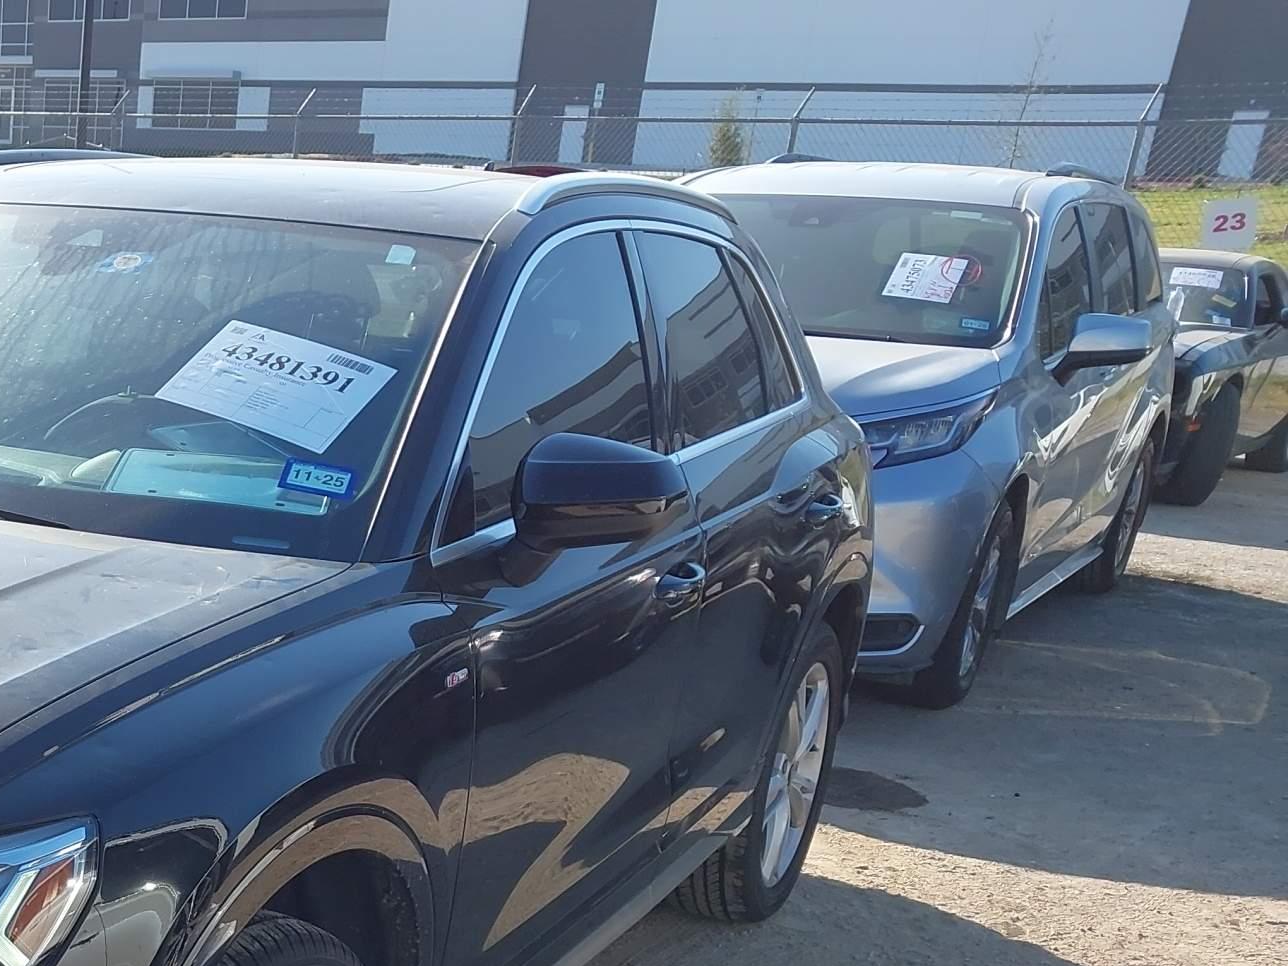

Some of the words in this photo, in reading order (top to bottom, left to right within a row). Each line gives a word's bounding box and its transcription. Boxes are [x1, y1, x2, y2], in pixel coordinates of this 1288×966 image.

[1212, 212, 1247, 233] 23
[221, 343, 356, 394] 43481391
[293, 468, 346, 488] 11-25
